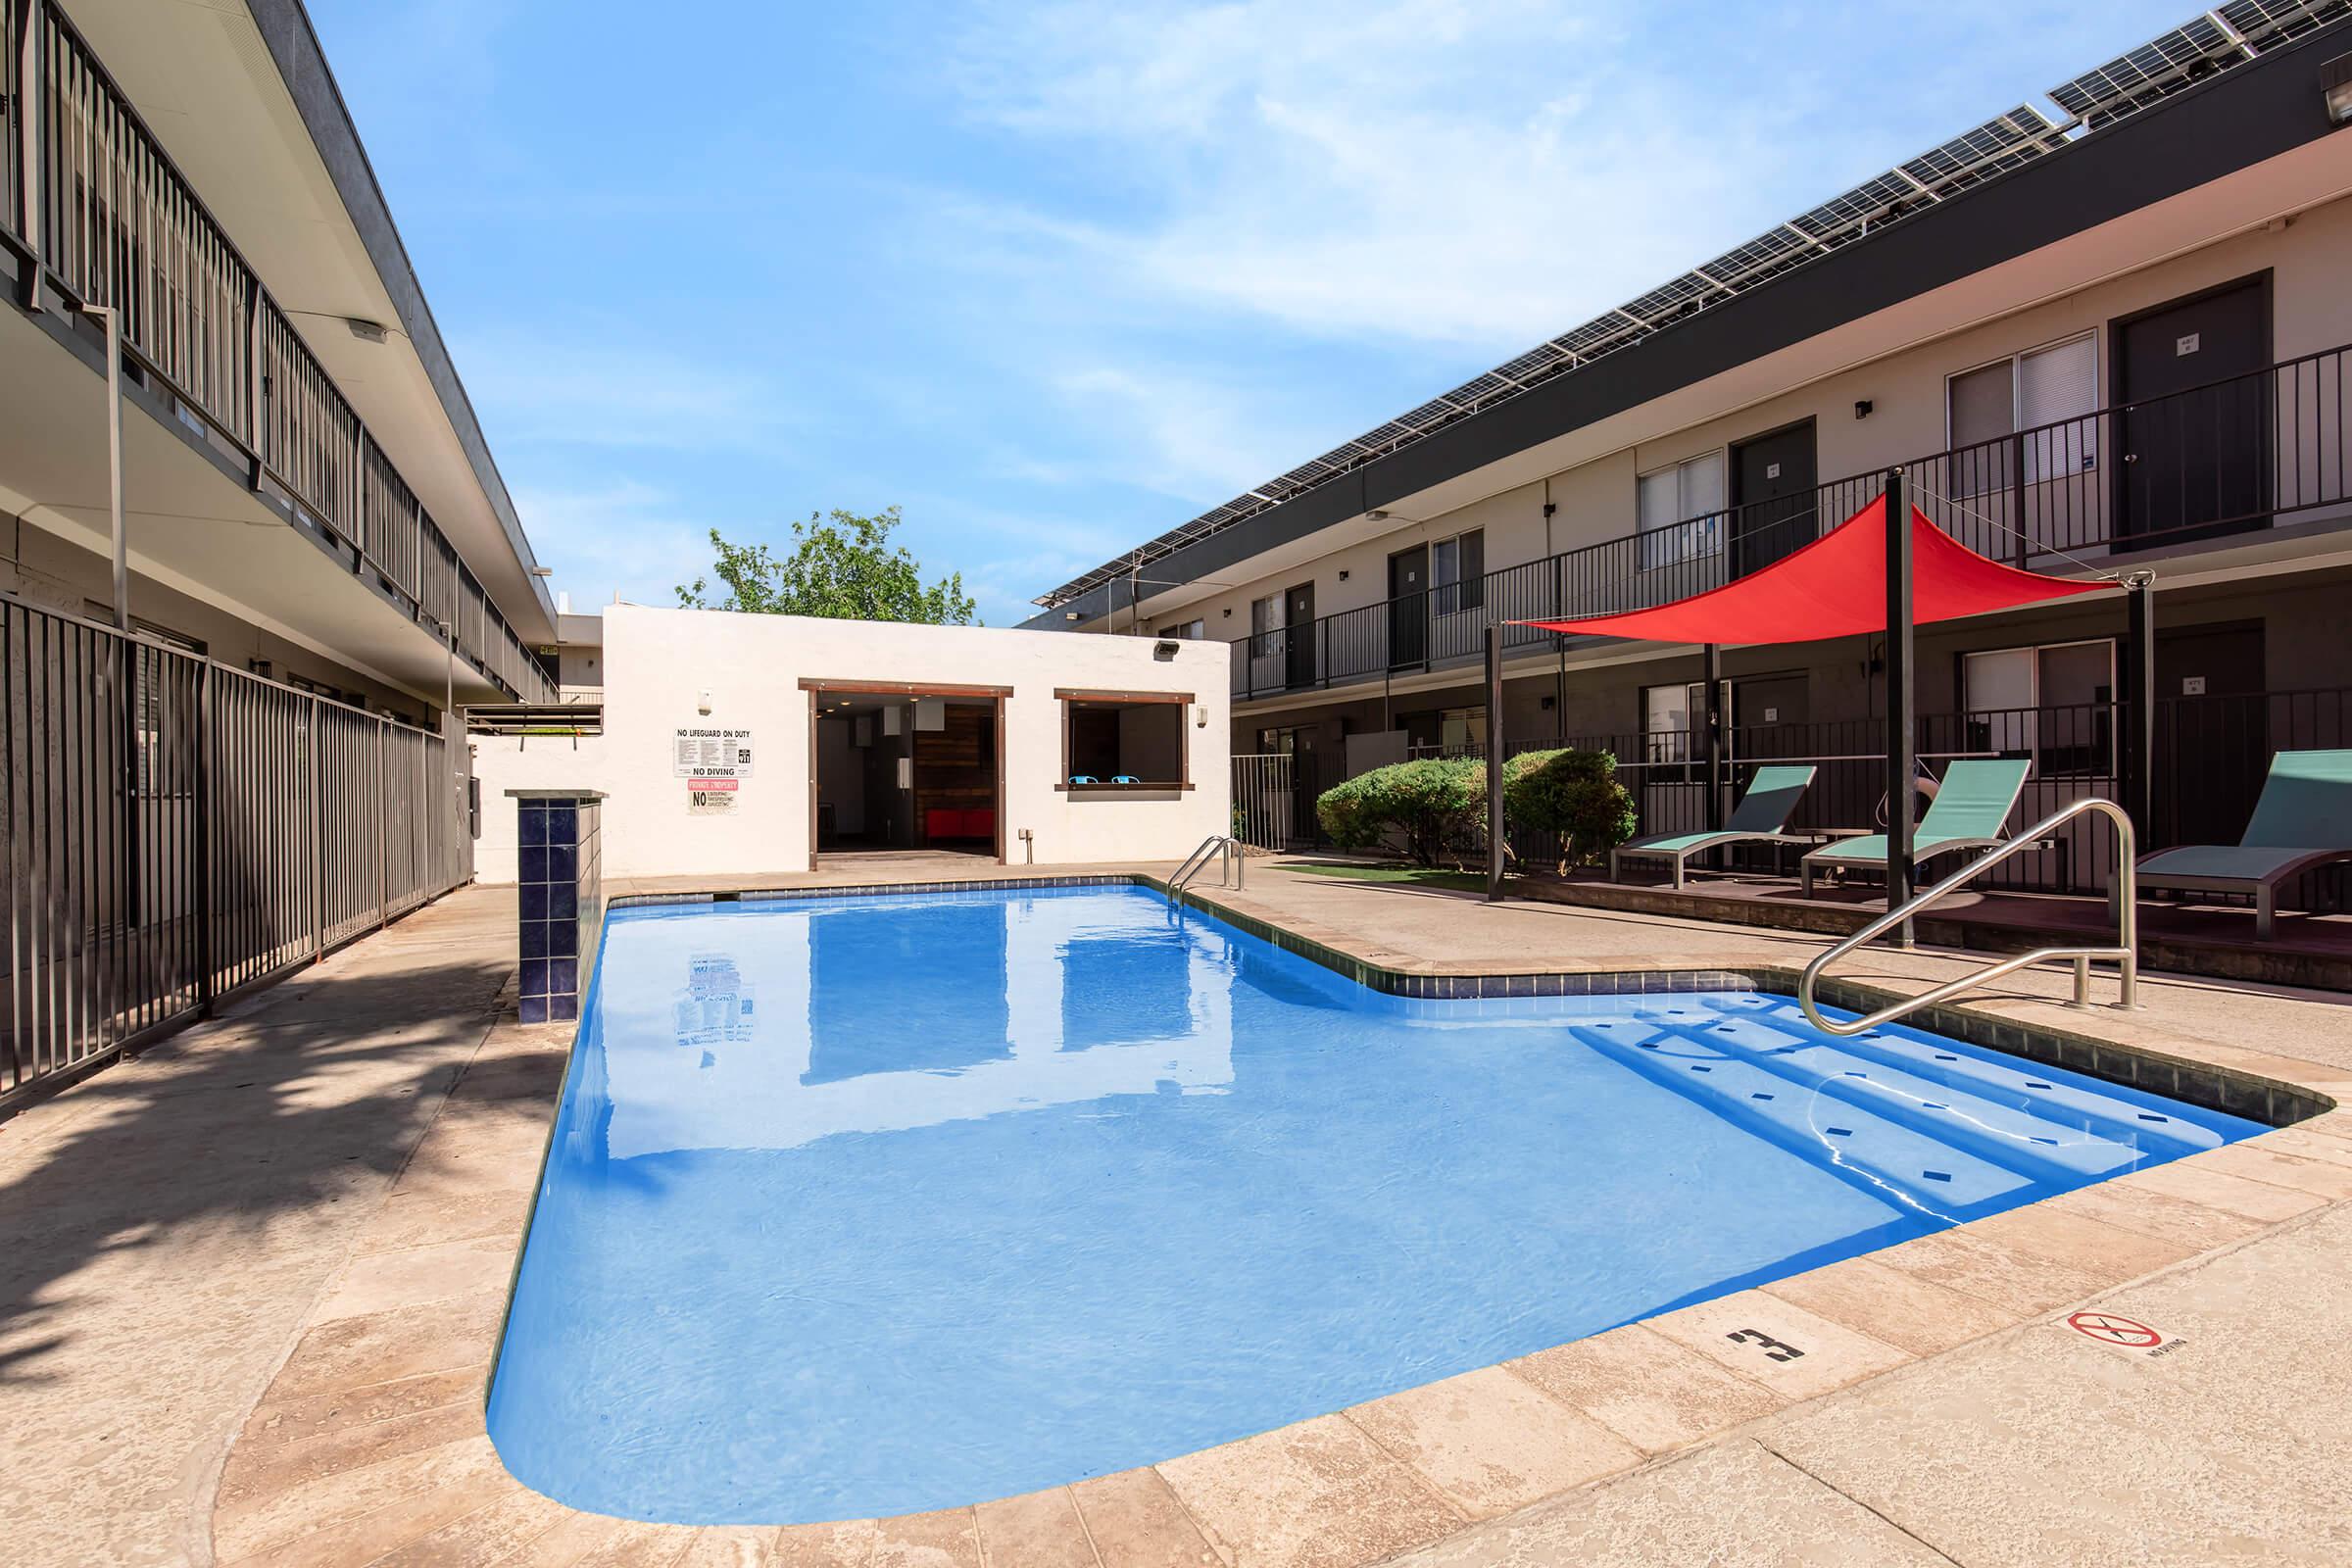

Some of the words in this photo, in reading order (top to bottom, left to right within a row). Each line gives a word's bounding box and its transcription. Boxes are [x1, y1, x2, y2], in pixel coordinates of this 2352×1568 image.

[689, 729, 721, 738] LIFEGUARD
[693, 767, 706, 776] NO
[707, 767, 735, 776] DIVING
[693, 791, 707, 807] NO
[1726, 1328, 1805, 1362] 3
[2146, 1349, 2164, 1358] NO
[2158, 1339, 2187, 1352] DIVING
